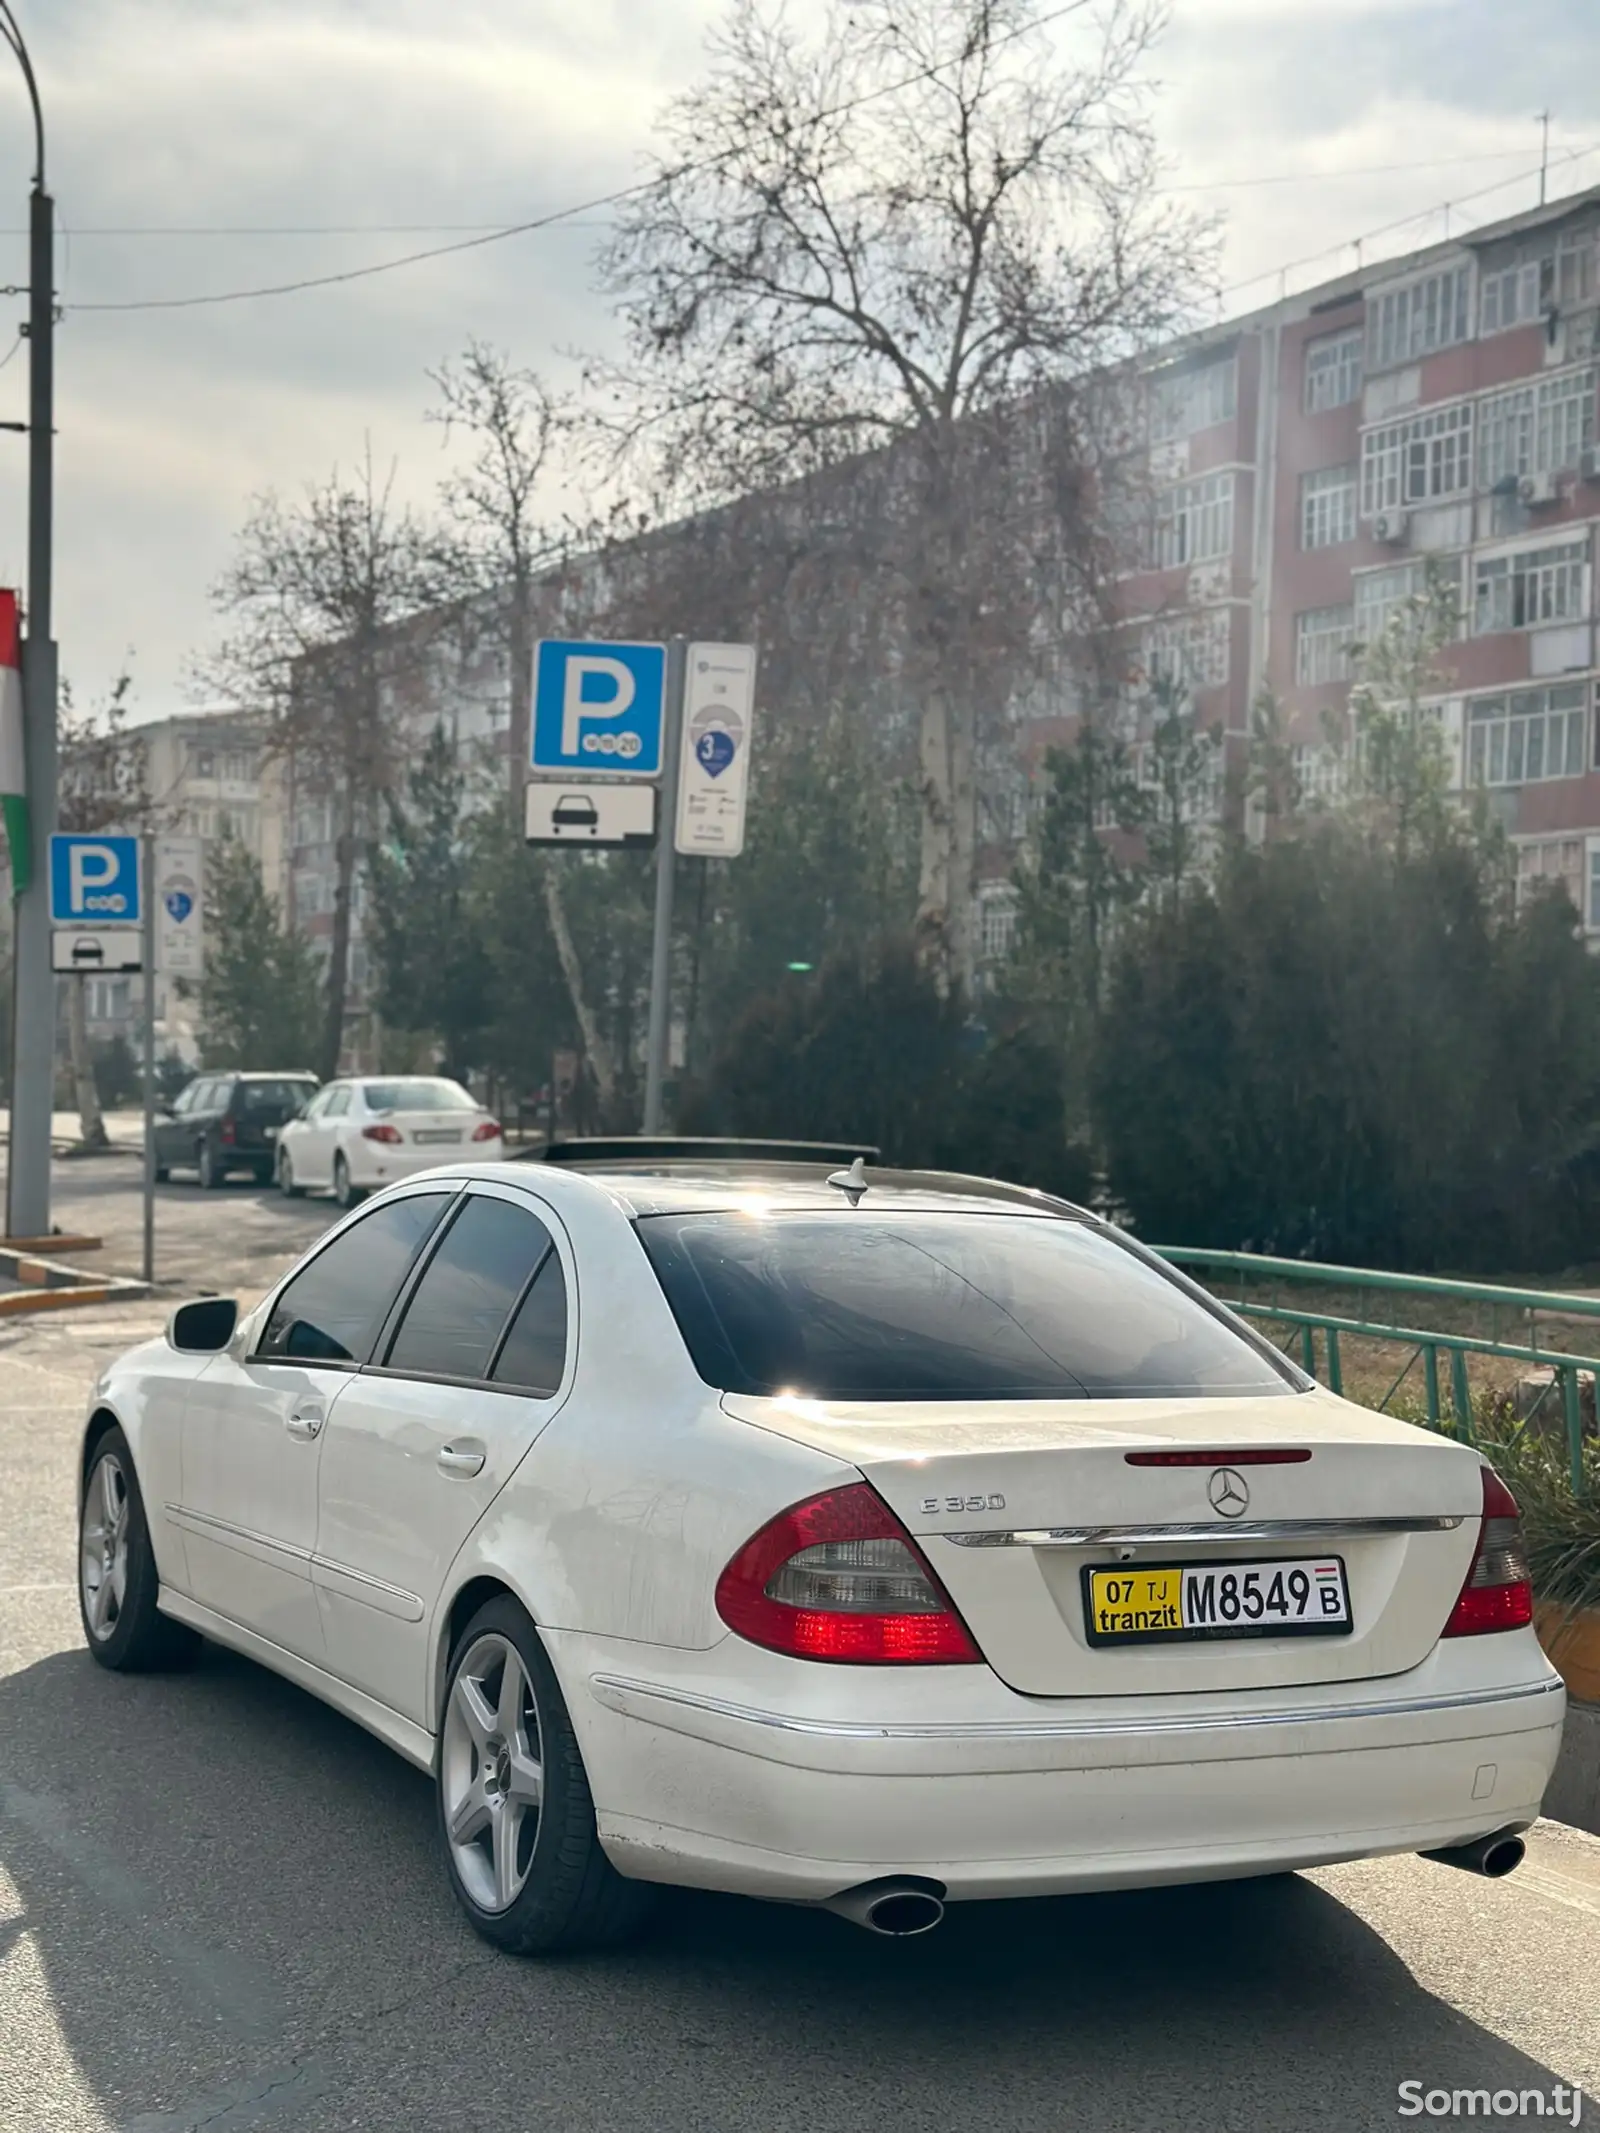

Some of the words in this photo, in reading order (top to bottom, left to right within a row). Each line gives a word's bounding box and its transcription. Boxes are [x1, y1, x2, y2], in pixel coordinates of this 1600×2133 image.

[560, 655, 636, 756] P
[701, 735, 714, 760] 3
[70, 844, 120, 913] P
[920, 1497, 940, 1514] E
[944, 1492, 1006, 1513] 350
[1106, 1580, 1135, 1604] 07
[1147, 1581, 1167, 1601] TJ
[1187, 1569, 1310, 1624] M8549
[1100, 1605, 1178, 1631] tranzit
